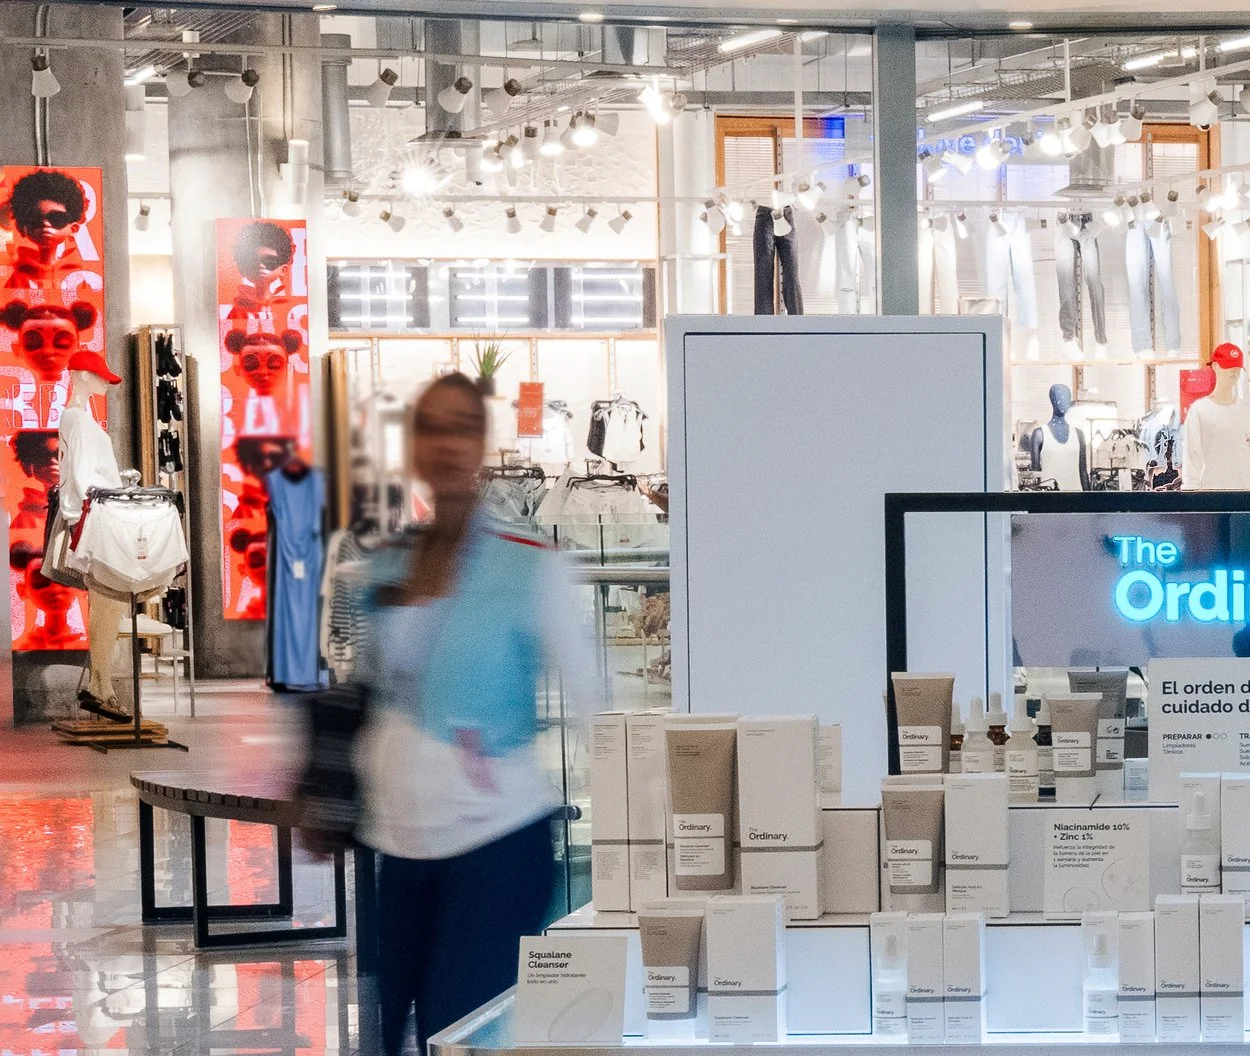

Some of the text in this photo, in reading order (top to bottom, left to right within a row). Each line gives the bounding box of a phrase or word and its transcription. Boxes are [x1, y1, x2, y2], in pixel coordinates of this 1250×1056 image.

[1114, 536, 1177, 565] The
[1162, 681, 1178, 695] El
[1183, 680, 1235, 695] orden
[1161, 699, 1233, 714] cuidado
[1053, 822, 1130, 831] Niacinamide 10%
[1060, 832, 1094, 841] Zinc 1%
[528, 951, 573, 960] Squalane
[528, 961, 569, 969] Cleanser
